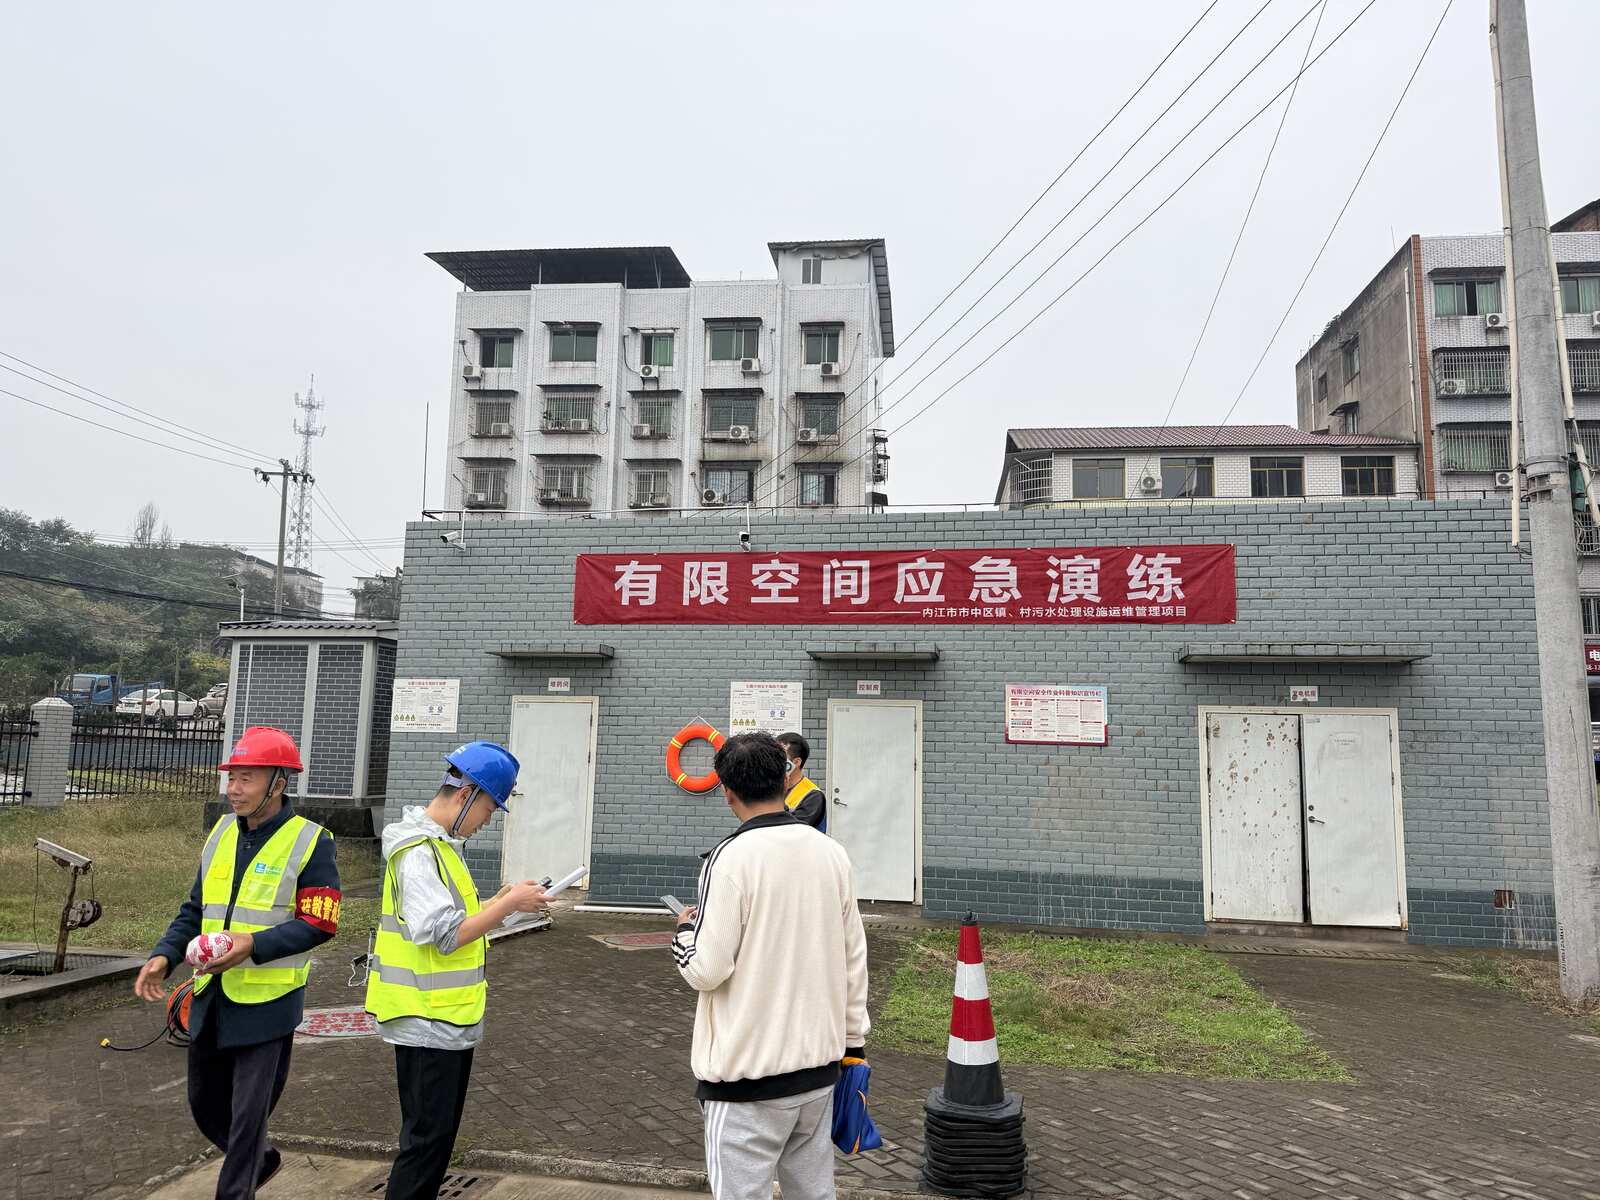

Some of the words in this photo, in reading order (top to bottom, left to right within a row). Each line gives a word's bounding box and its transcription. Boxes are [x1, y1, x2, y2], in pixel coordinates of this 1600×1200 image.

[614, 553, 1185, 607] 有限空间应急演练
[922, 606, 1187, 619] 内江市市中区镇、村污水处理设施运维管理项目
